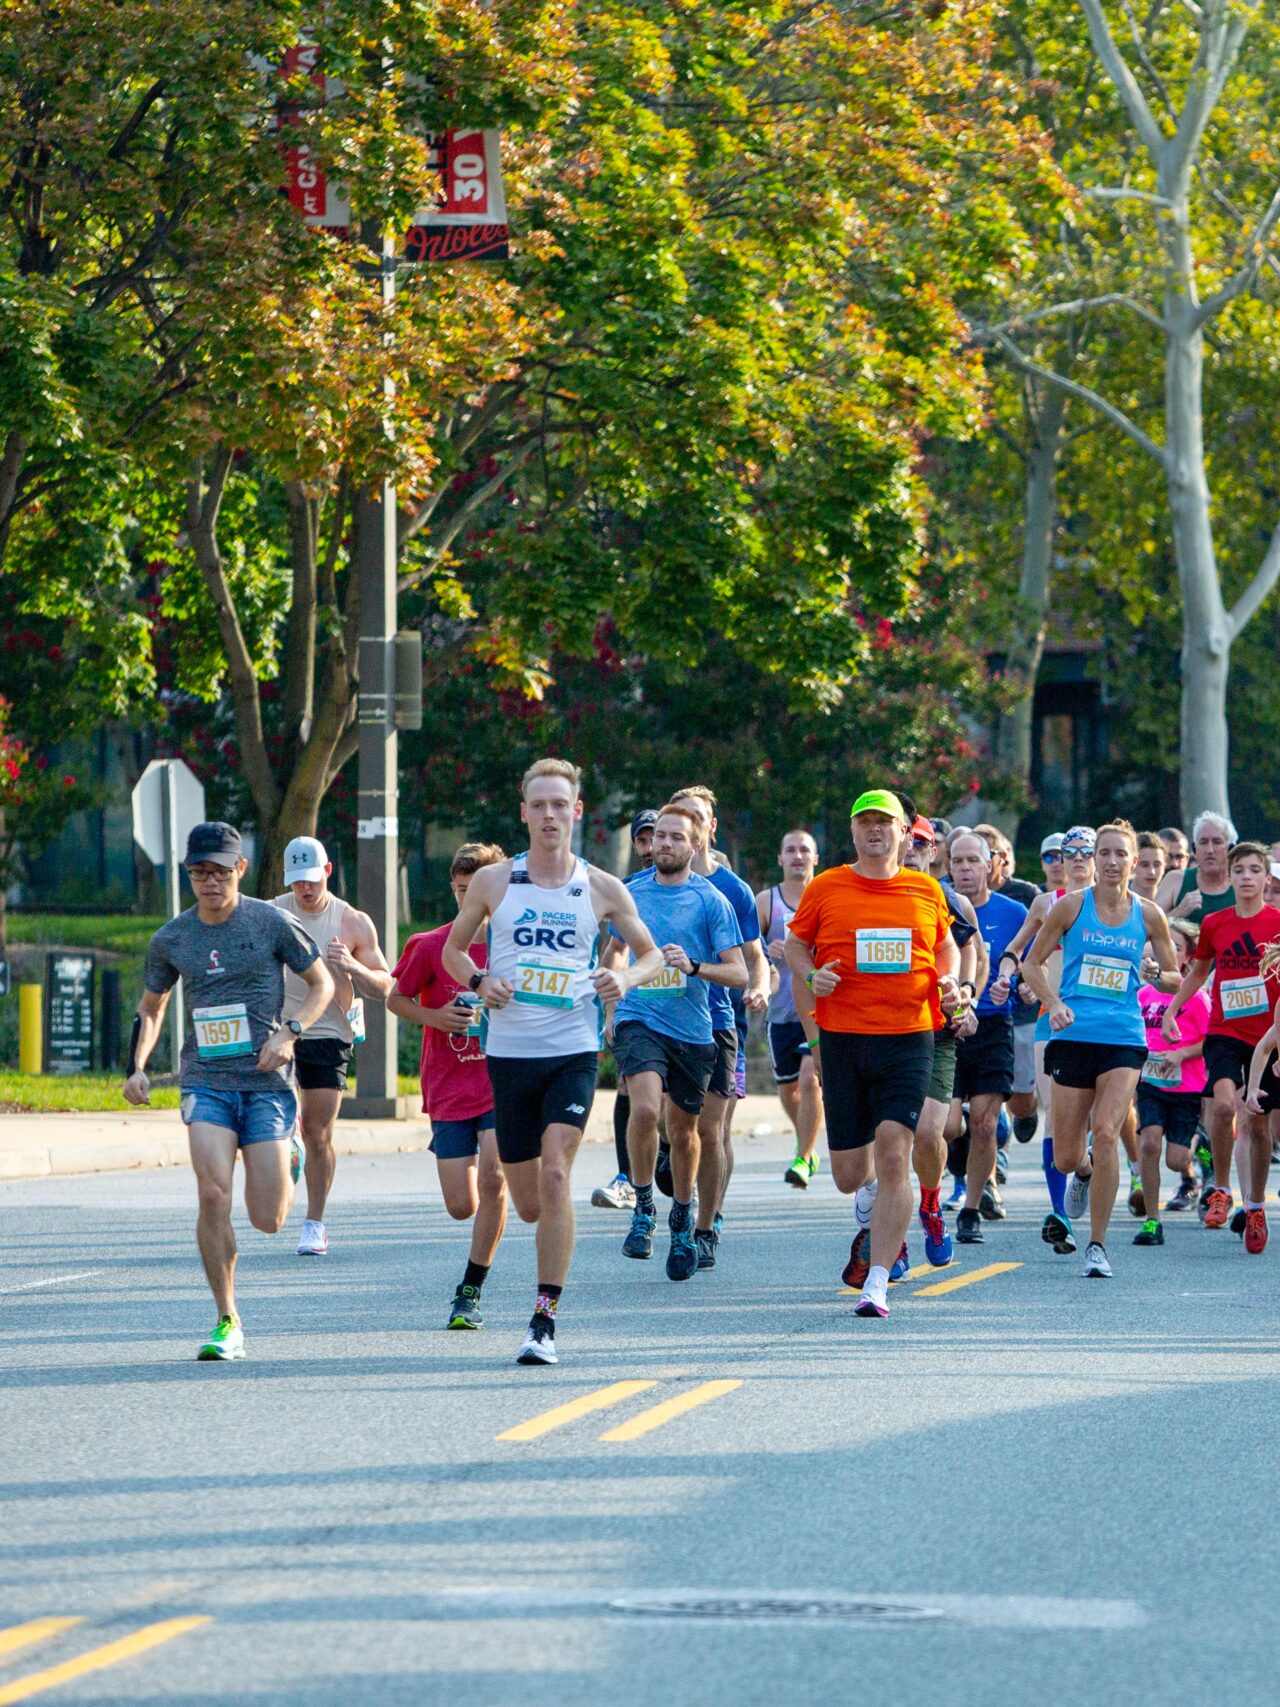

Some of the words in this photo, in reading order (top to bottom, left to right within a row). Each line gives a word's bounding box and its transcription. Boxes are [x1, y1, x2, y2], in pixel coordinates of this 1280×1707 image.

[453, 153, 485, 202] 30
[303, 192, 318, 214] AT
[404, 222, 509, 262] Orioles
[541, 911, 577, 921] PACERS
[541, 919, 577, 928] RUNNING
[513, 926, 576, 952] GRC
[864, 941, 906, 962] 1659
[1218, 956, 1261, 971] adida
[521, 968, 570, 996] 2147
[642, 967, 682, 989] 04
[1088, 966, 1124, 990] 1542
[1226, 987, 1262, 1009] 2067
[200, 1018, 241, 1045] 1597
